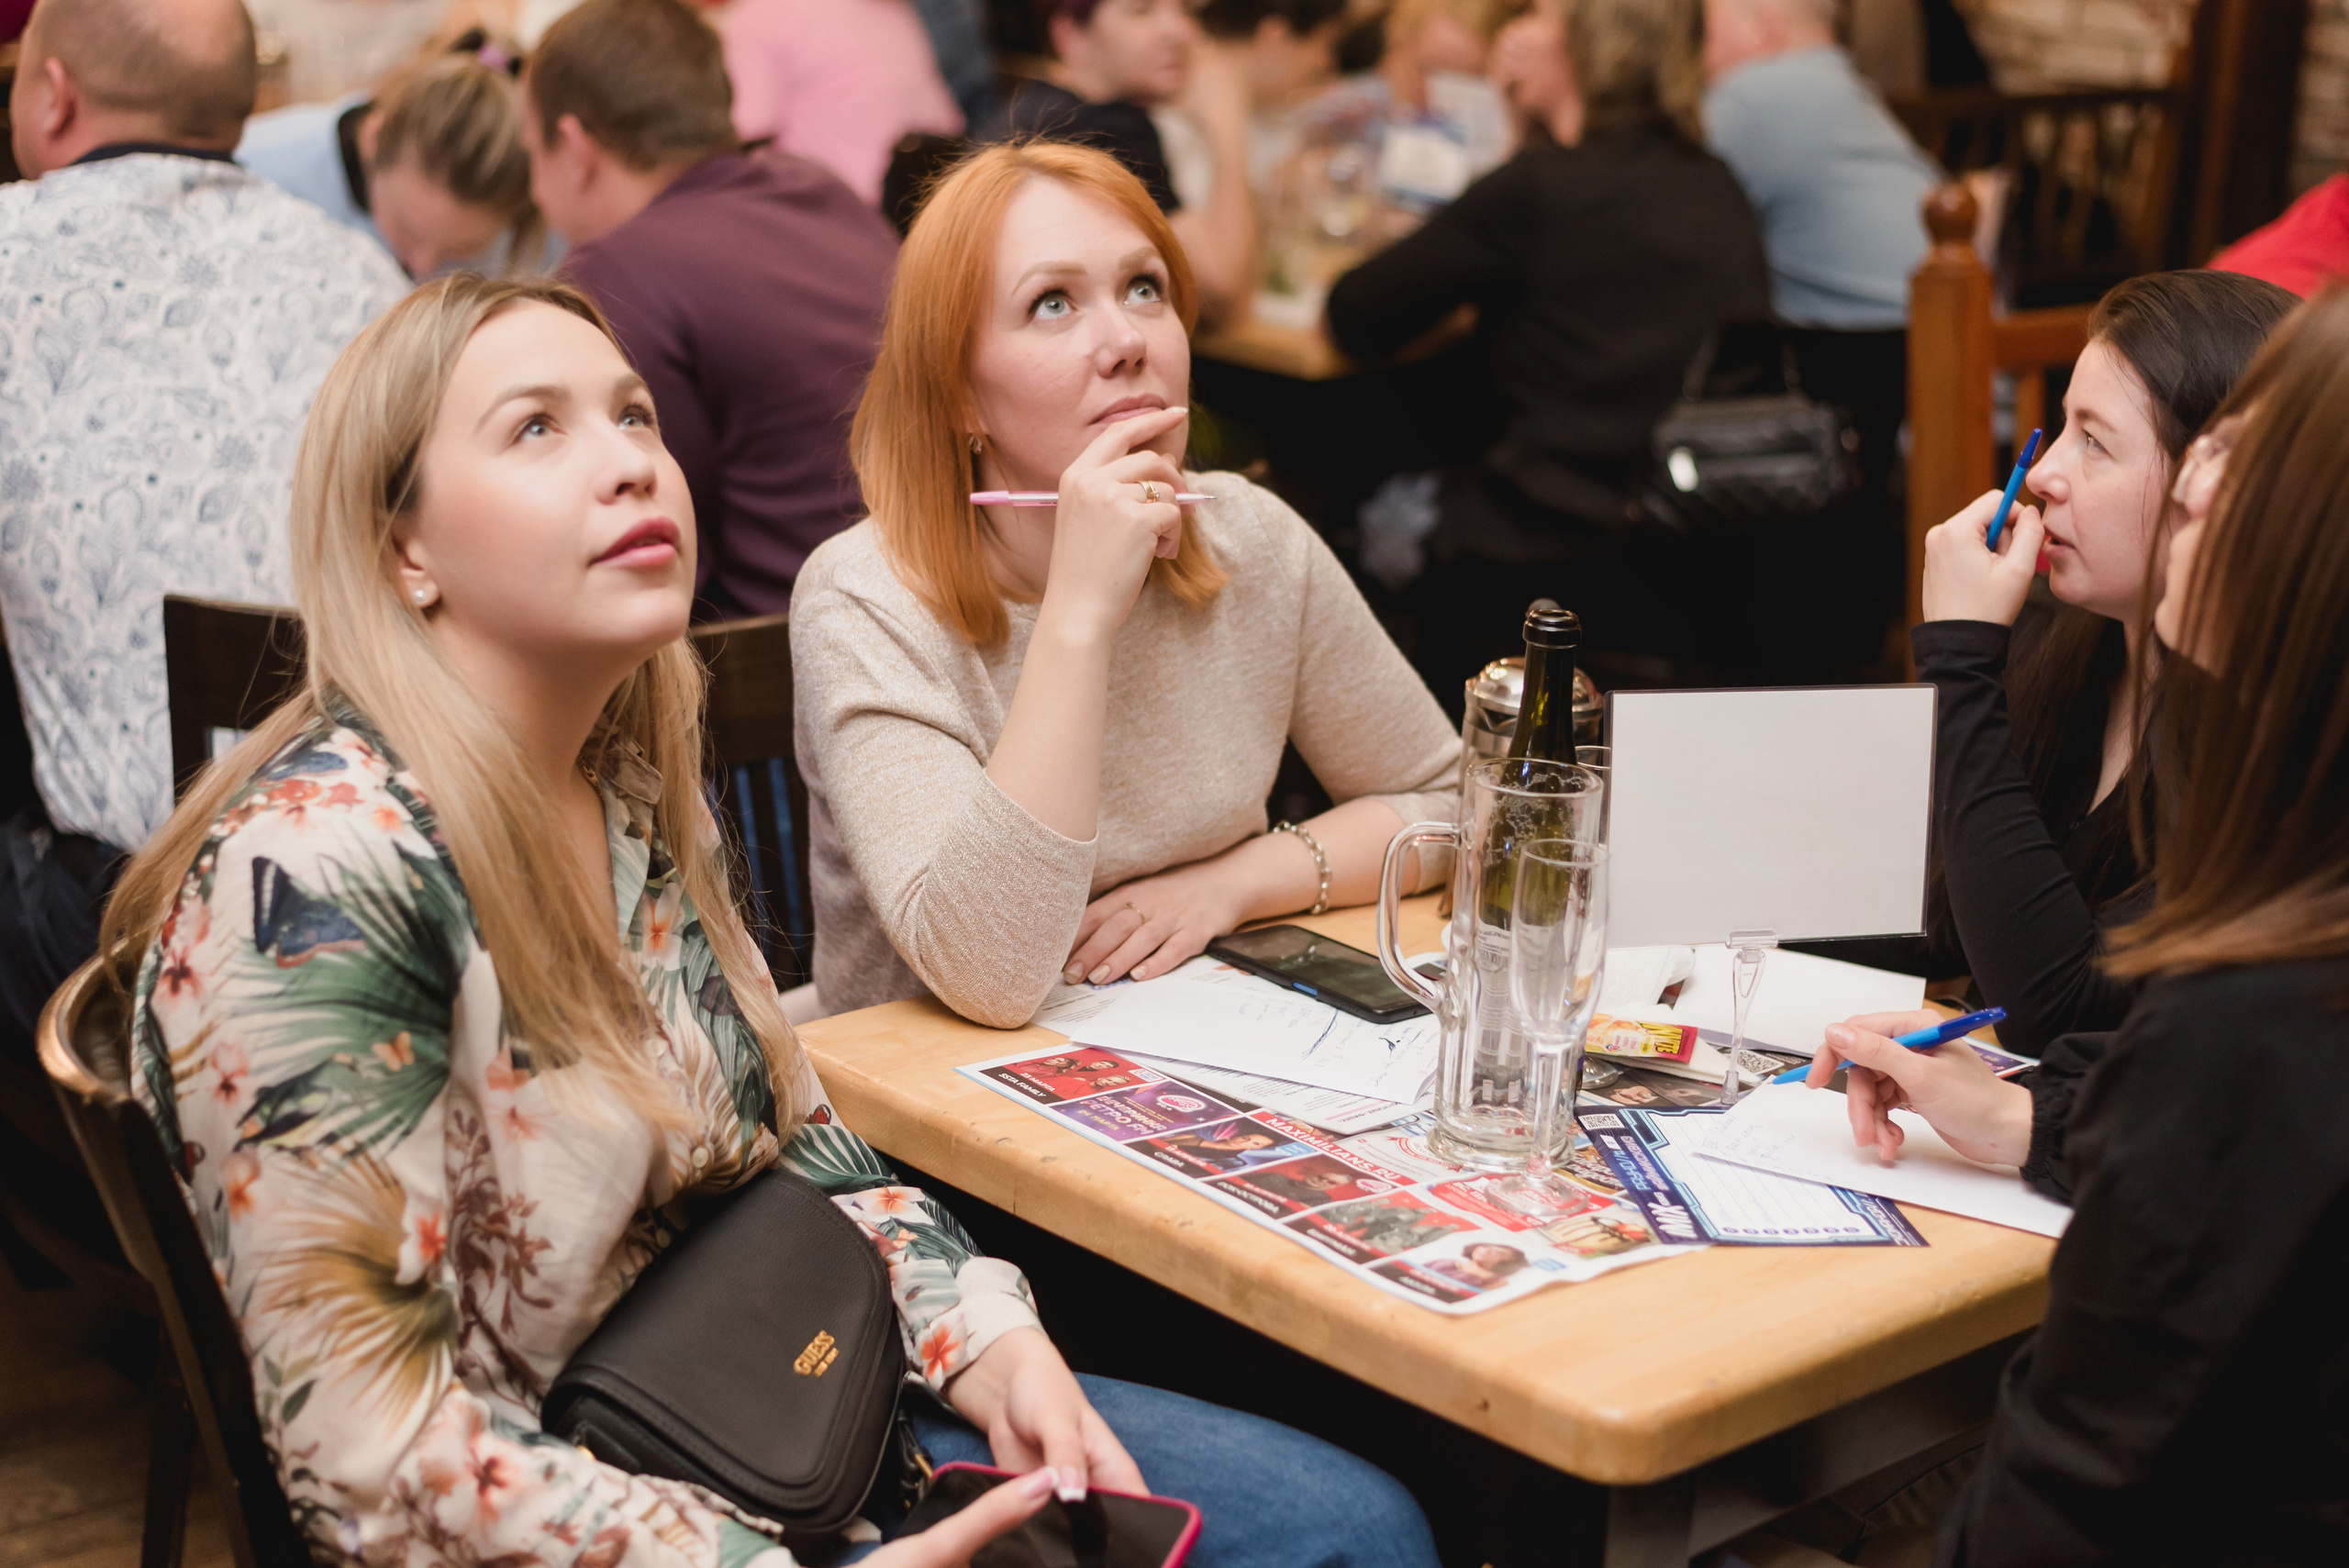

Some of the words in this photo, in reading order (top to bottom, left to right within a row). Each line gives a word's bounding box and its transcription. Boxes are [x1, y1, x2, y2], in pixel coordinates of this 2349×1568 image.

[1078, 1099, 1132, 1124] РЕТРО
[1097, 1095, 1168, 1132] ВЕЧЕРИНКА
[1265, 1118, 1401, 1181] MAXIMILIANS.RU
[793, 1329, 836, 1375] GUESS
